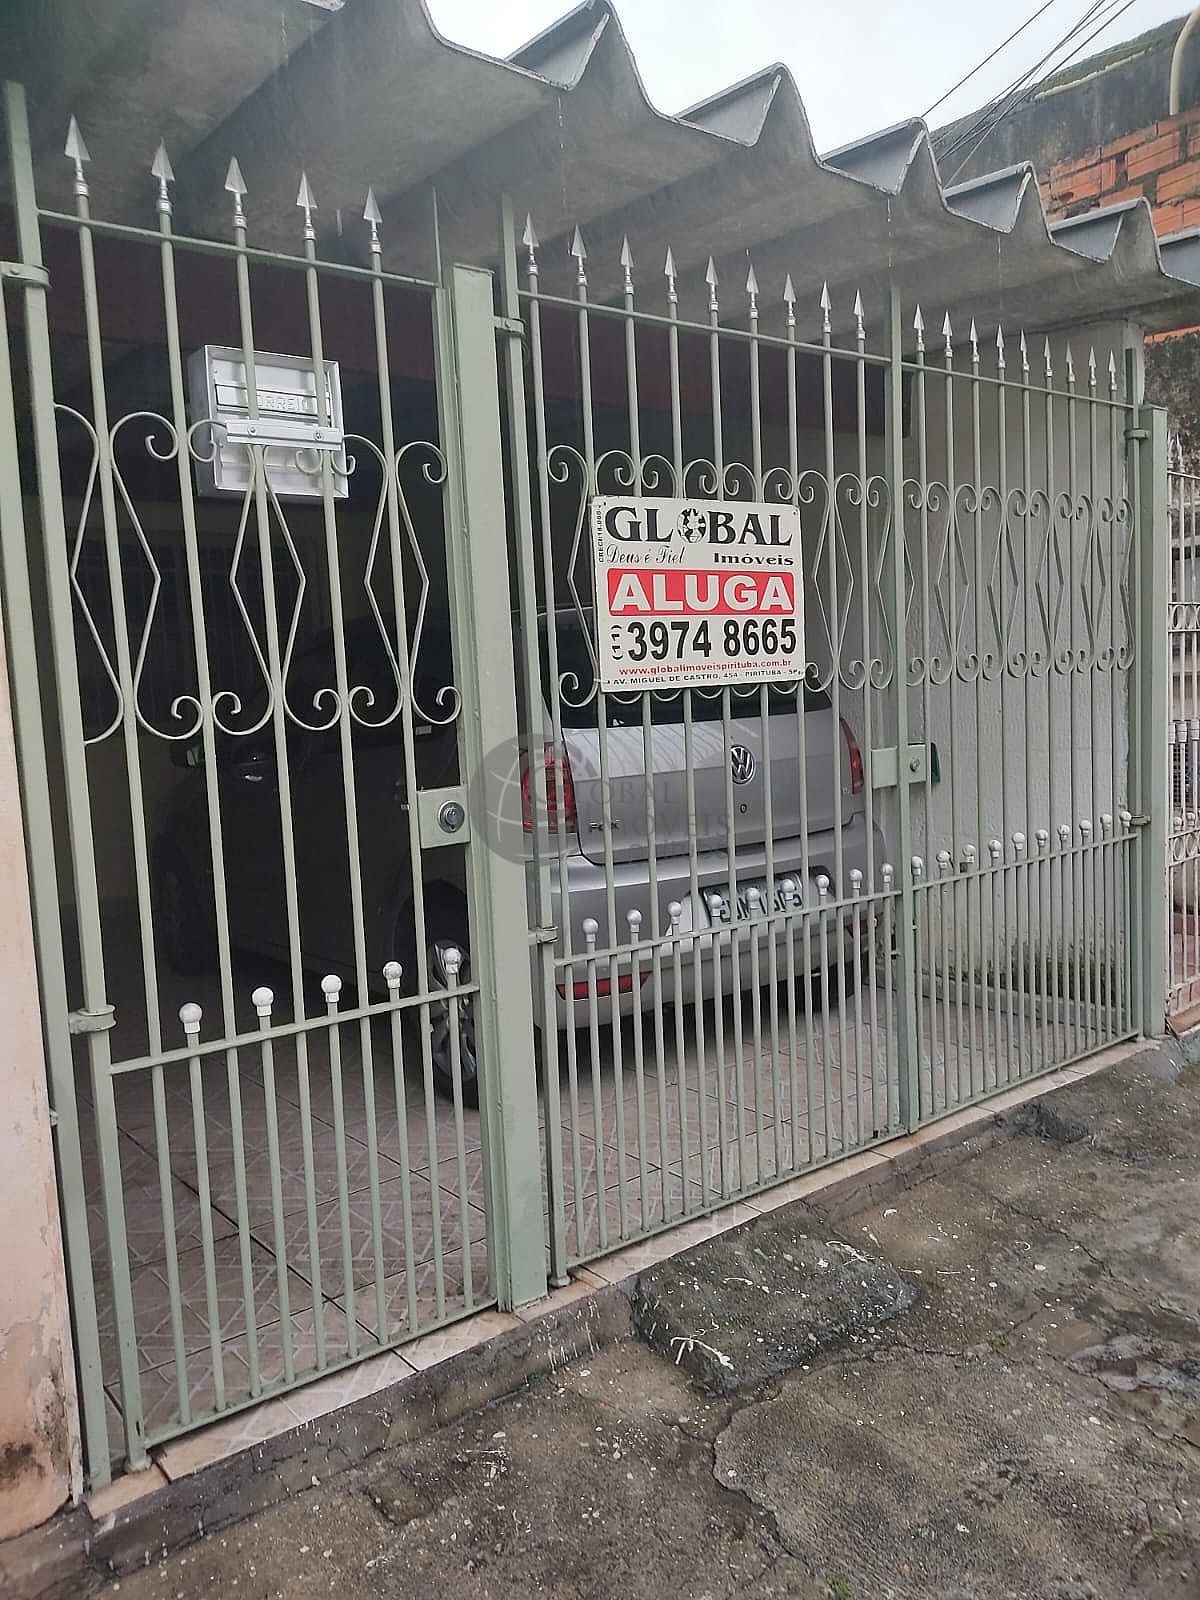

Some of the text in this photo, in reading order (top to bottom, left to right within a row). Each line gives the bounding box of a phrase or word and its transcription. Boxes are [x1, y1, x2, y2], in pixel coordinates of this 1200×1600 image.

[606, 544, 640, 563] Deus
[656, 544, 686, 563] Fiel
[713, 552, 794, 566] Imóveis
[610, 573, 794, 611] ALUGA
[627, 620, 712, 662] 3974
[723, 619, 797, 657] 8665
[619, 658, 792, 675] www.globalimoveispirituba.com.br
[630, 675, 666, 685] MIGUEL
[745, 668, 782, 677] PIRITUBA
